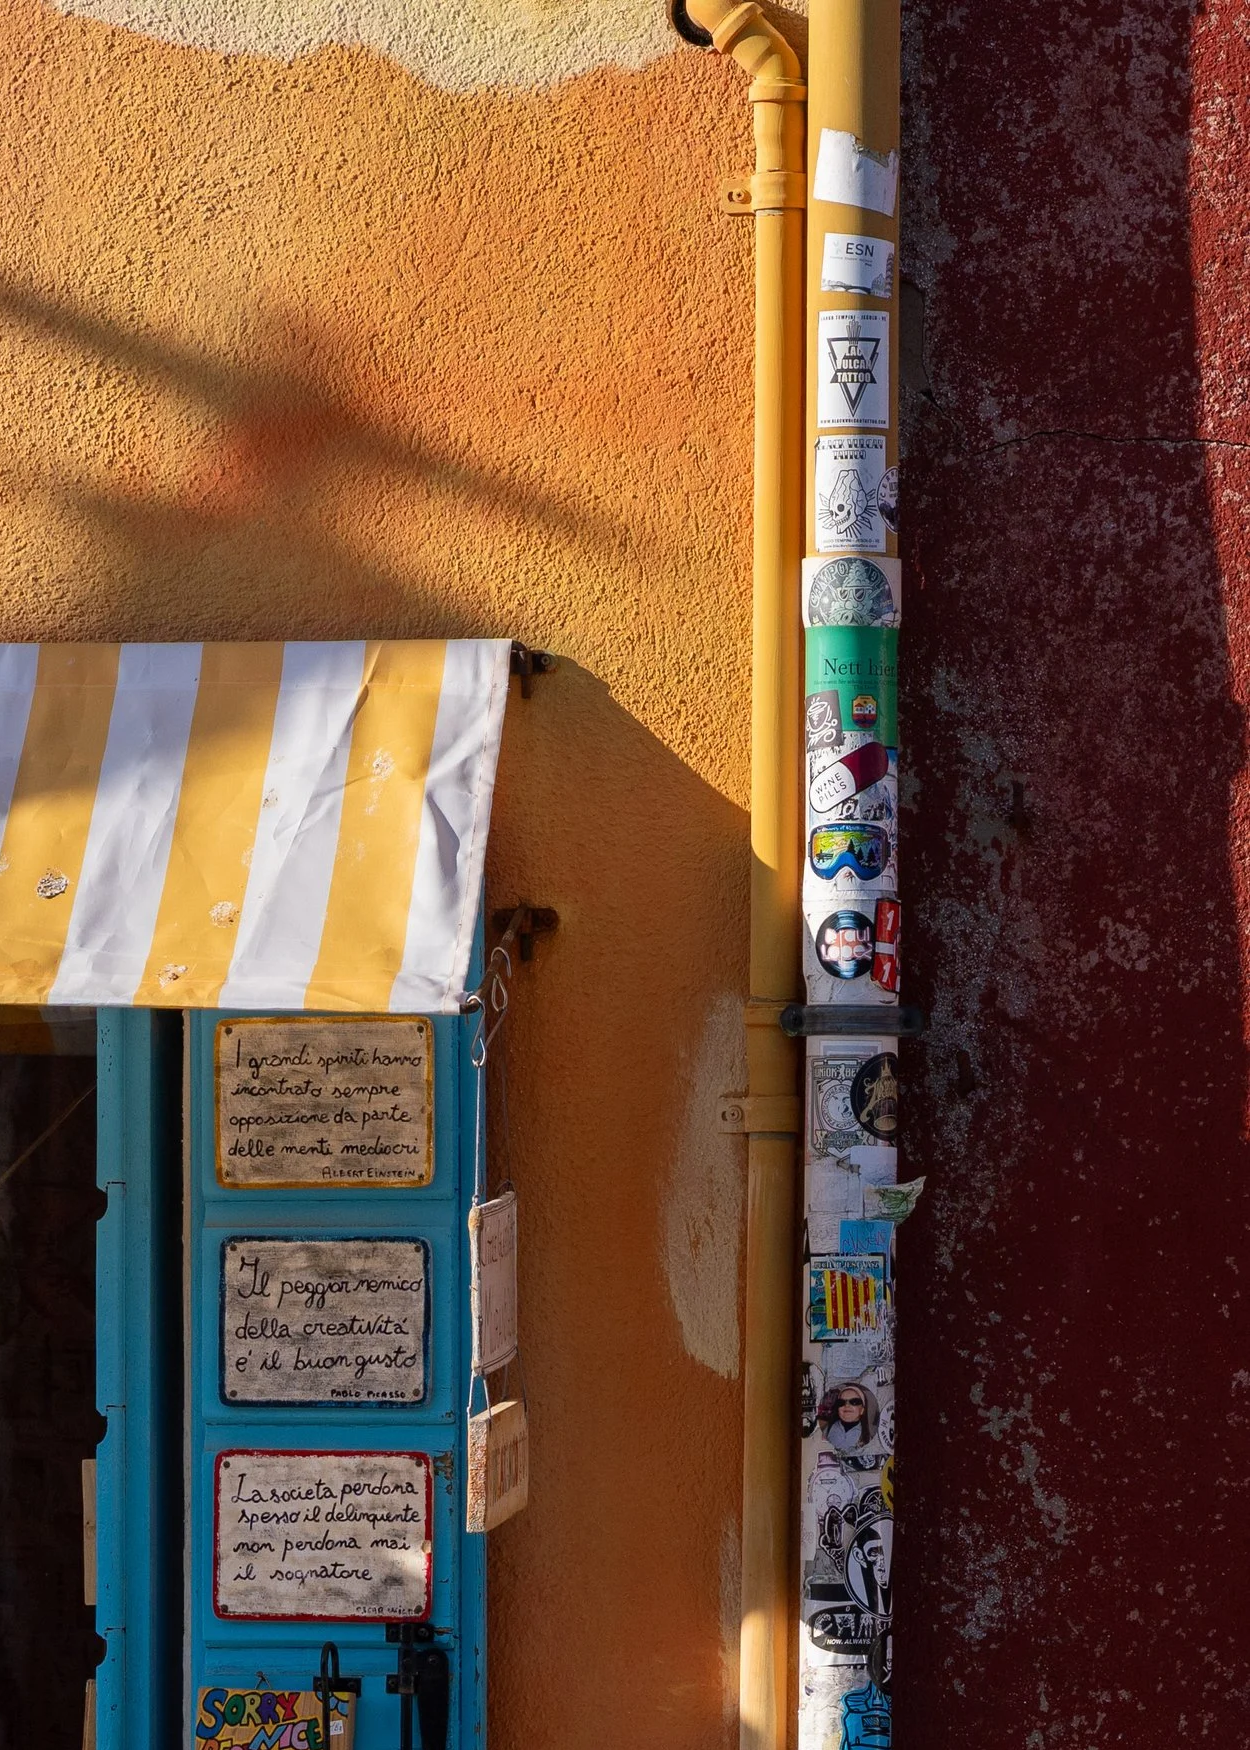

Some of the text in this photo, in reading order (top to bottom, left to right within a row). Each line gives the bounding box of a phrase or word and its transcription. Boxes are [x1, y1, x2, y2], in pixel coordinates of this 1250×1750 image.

[846, 242, 874, 257] ESN
[837, 372, 871, 382] TATTOO
[824, 658, 862, 676] Nett
[818, 781, 847, 805] PILLS
[249, 1043, 313, 1080] grandi
[317, 1047, 370, 1075] spiriti
[371, 1047, 422, 1067] hanno
[231, 1077, 402, 1102] incontrato sempre
[229, 1104, 412, 1133] opposizione da parte
[228, 1136, 420, 1157] delle menti mediocri
[238, 1256, 424, 1309] Il peggior nemico
[235, 1312, 293, 1340] della
[260, 1350, 283, 1371] il
[293, 1347, 352, 1371] buon
[355, 1345, 418, 1380] gusto
[330, 1388, 361, 1398] PABLO
[231, 1473, 268, 1504] La
[340, 1472, 419, 1506] perdona
[238, 1502, 422, 1531] spesso il delinquente
[232, 1529, 411, 1562] non perdona mai
[232, 1561, 374, 1590] il sognatore
[196, 1687, 300, 1740] SORRY
